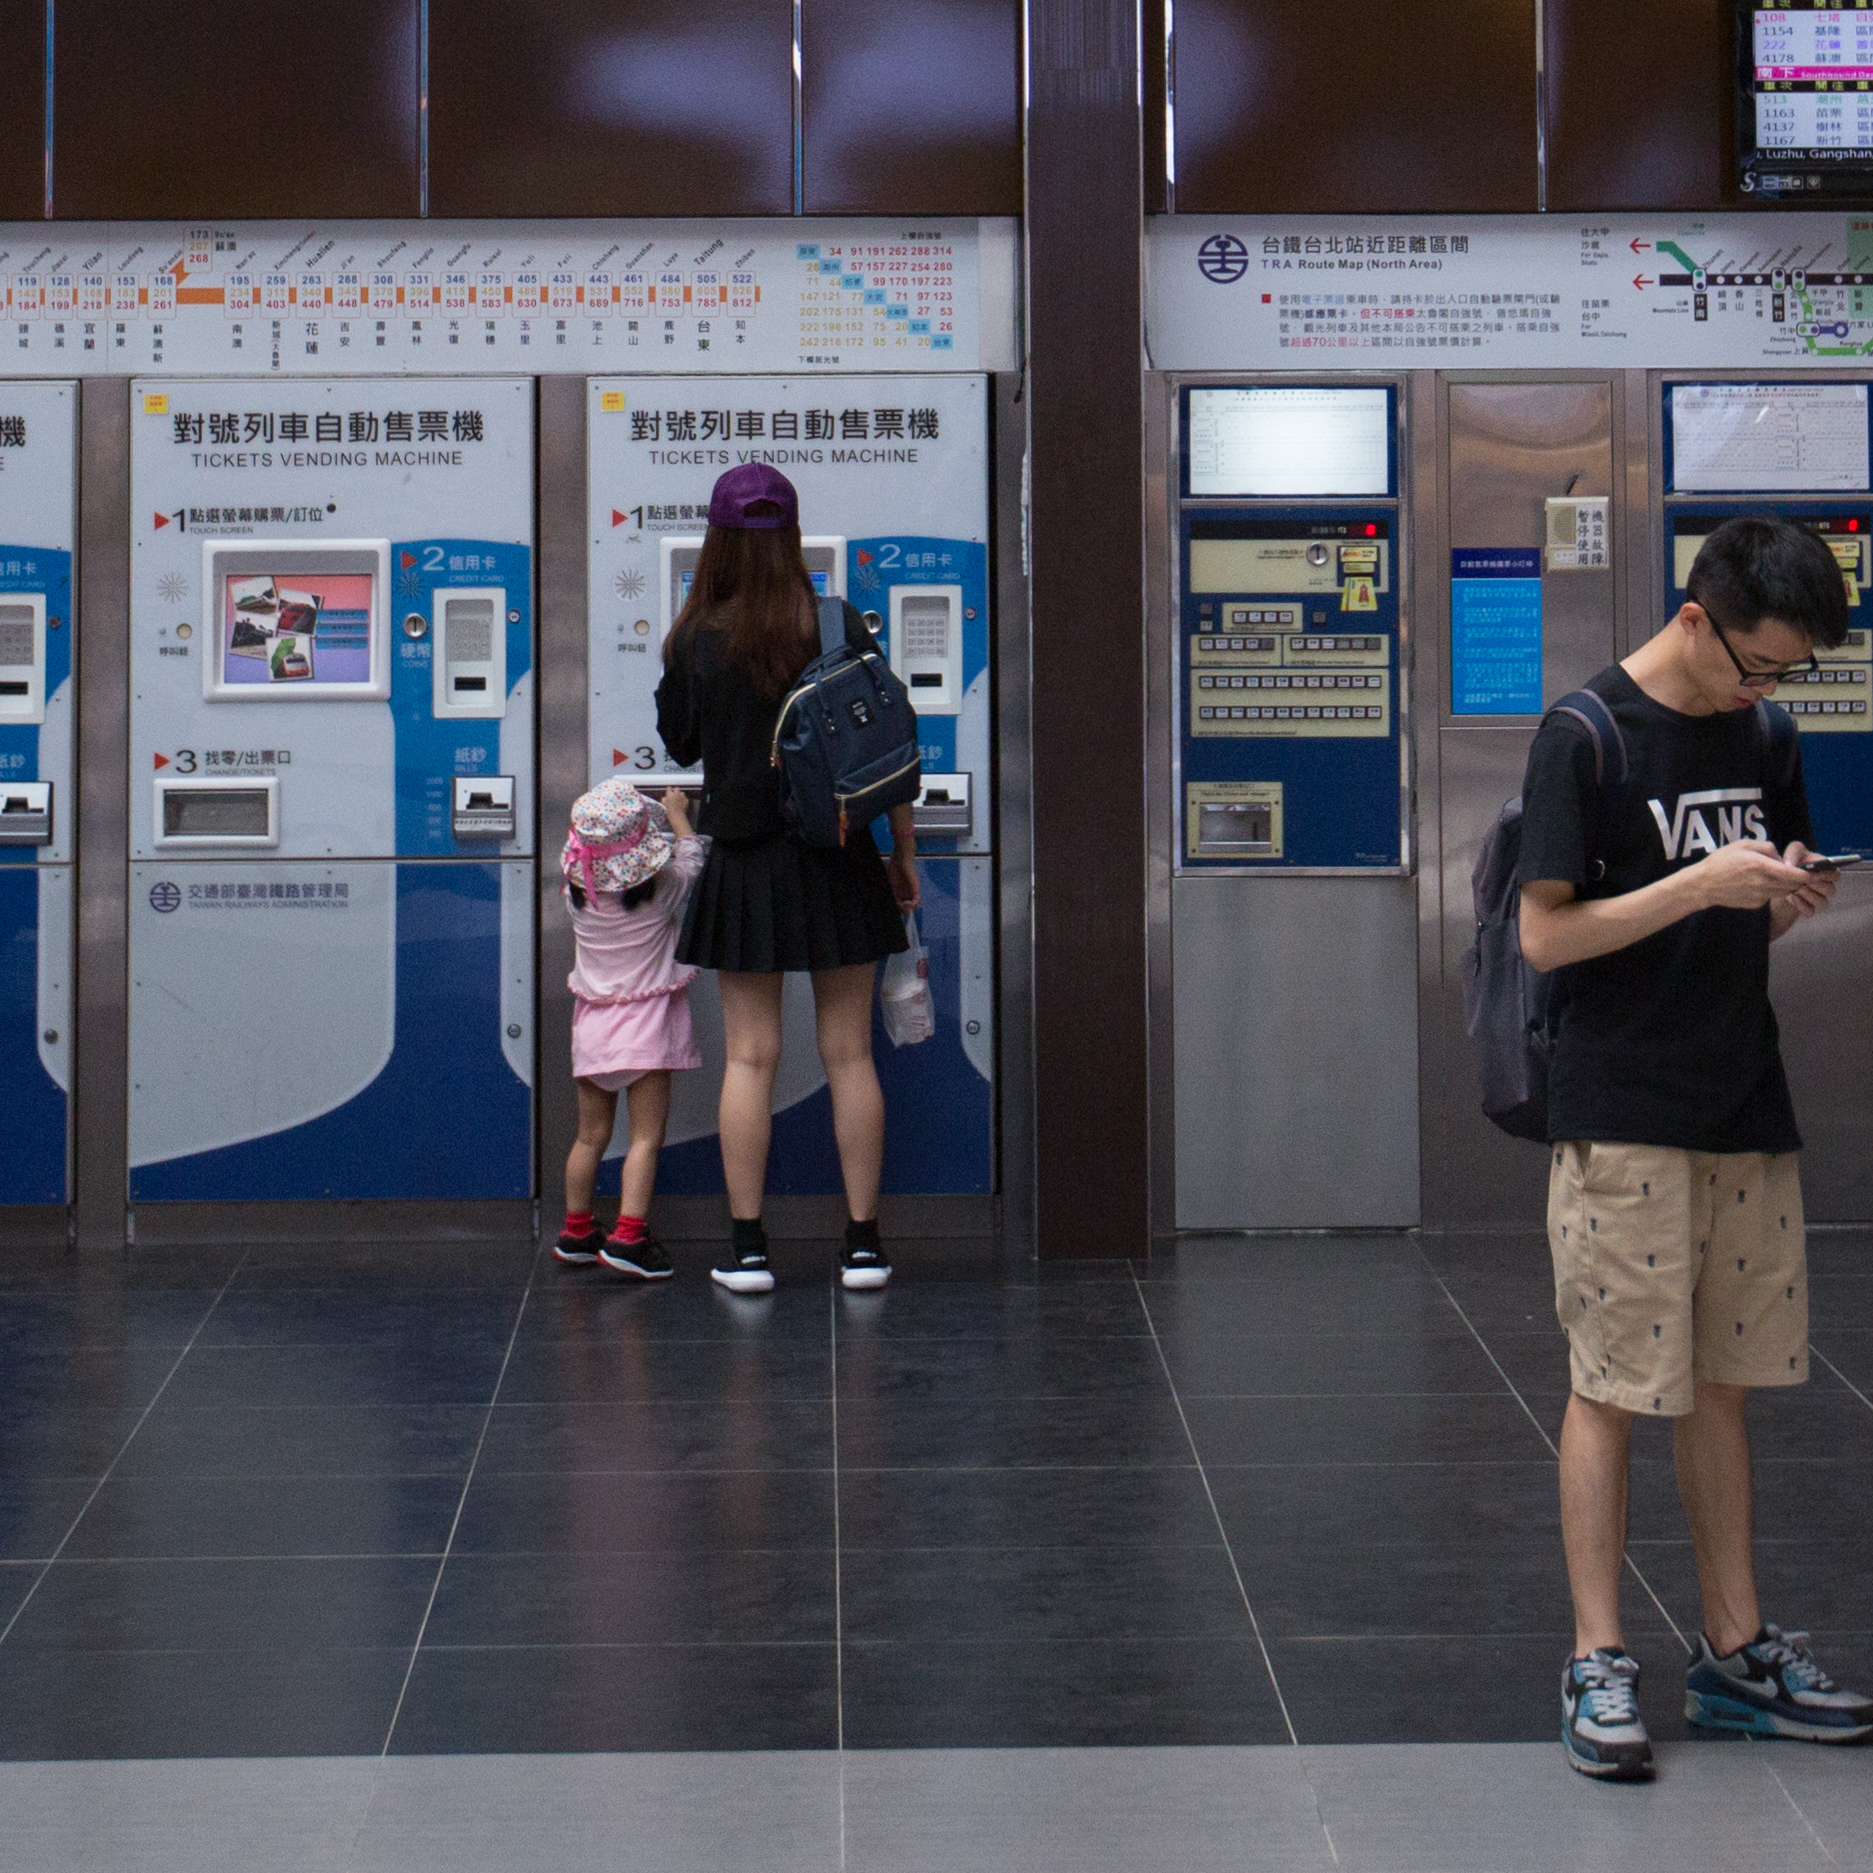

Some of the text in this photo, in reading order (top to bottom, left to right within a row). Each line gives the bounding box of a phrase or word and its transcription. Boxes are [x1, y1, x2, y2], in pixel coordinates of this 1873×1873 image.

[1757, 67, 1795, 78] 南下
[1766, 149, 1806, 160] Luzhu,
[694, 238, 724, 266] Taitung
[1262, 236, 1469, 254] 台鐵台北站近距離區間
[1299, 260, 1335, 269] Route
[1338, 260, 1362, 271] Map
[1367, 259, 1406, 270] (North
[1409, 259, 1442, 270] Area)
[698, 320, 710, 351] 台東
[173, 411, 484, 445] 對號列車自動售票機
[631, 408, 940, 442] 對號列車自動售票機
[192, 451, 462, 468] TICKETS VENDING MACHINE
[650, 449, 918, 465] TICKETS VENDING MACHINE
[173, 508, 186, 533] 1
[630, 504, 710, 529] 1 點選螢幕
[1578, 510, 1589, 565] 暫停使用
[423, 547, 496, 571] 2 信用卡
[879, 544, 952, 568] 2 信用卡
[176, 750, 291, 773] 3 找零/出票口
[635, 746, 655, 770] 3
[1648, 787, 1769, 861] VANS
[227, 901, 268, 909] RAILWAYS
